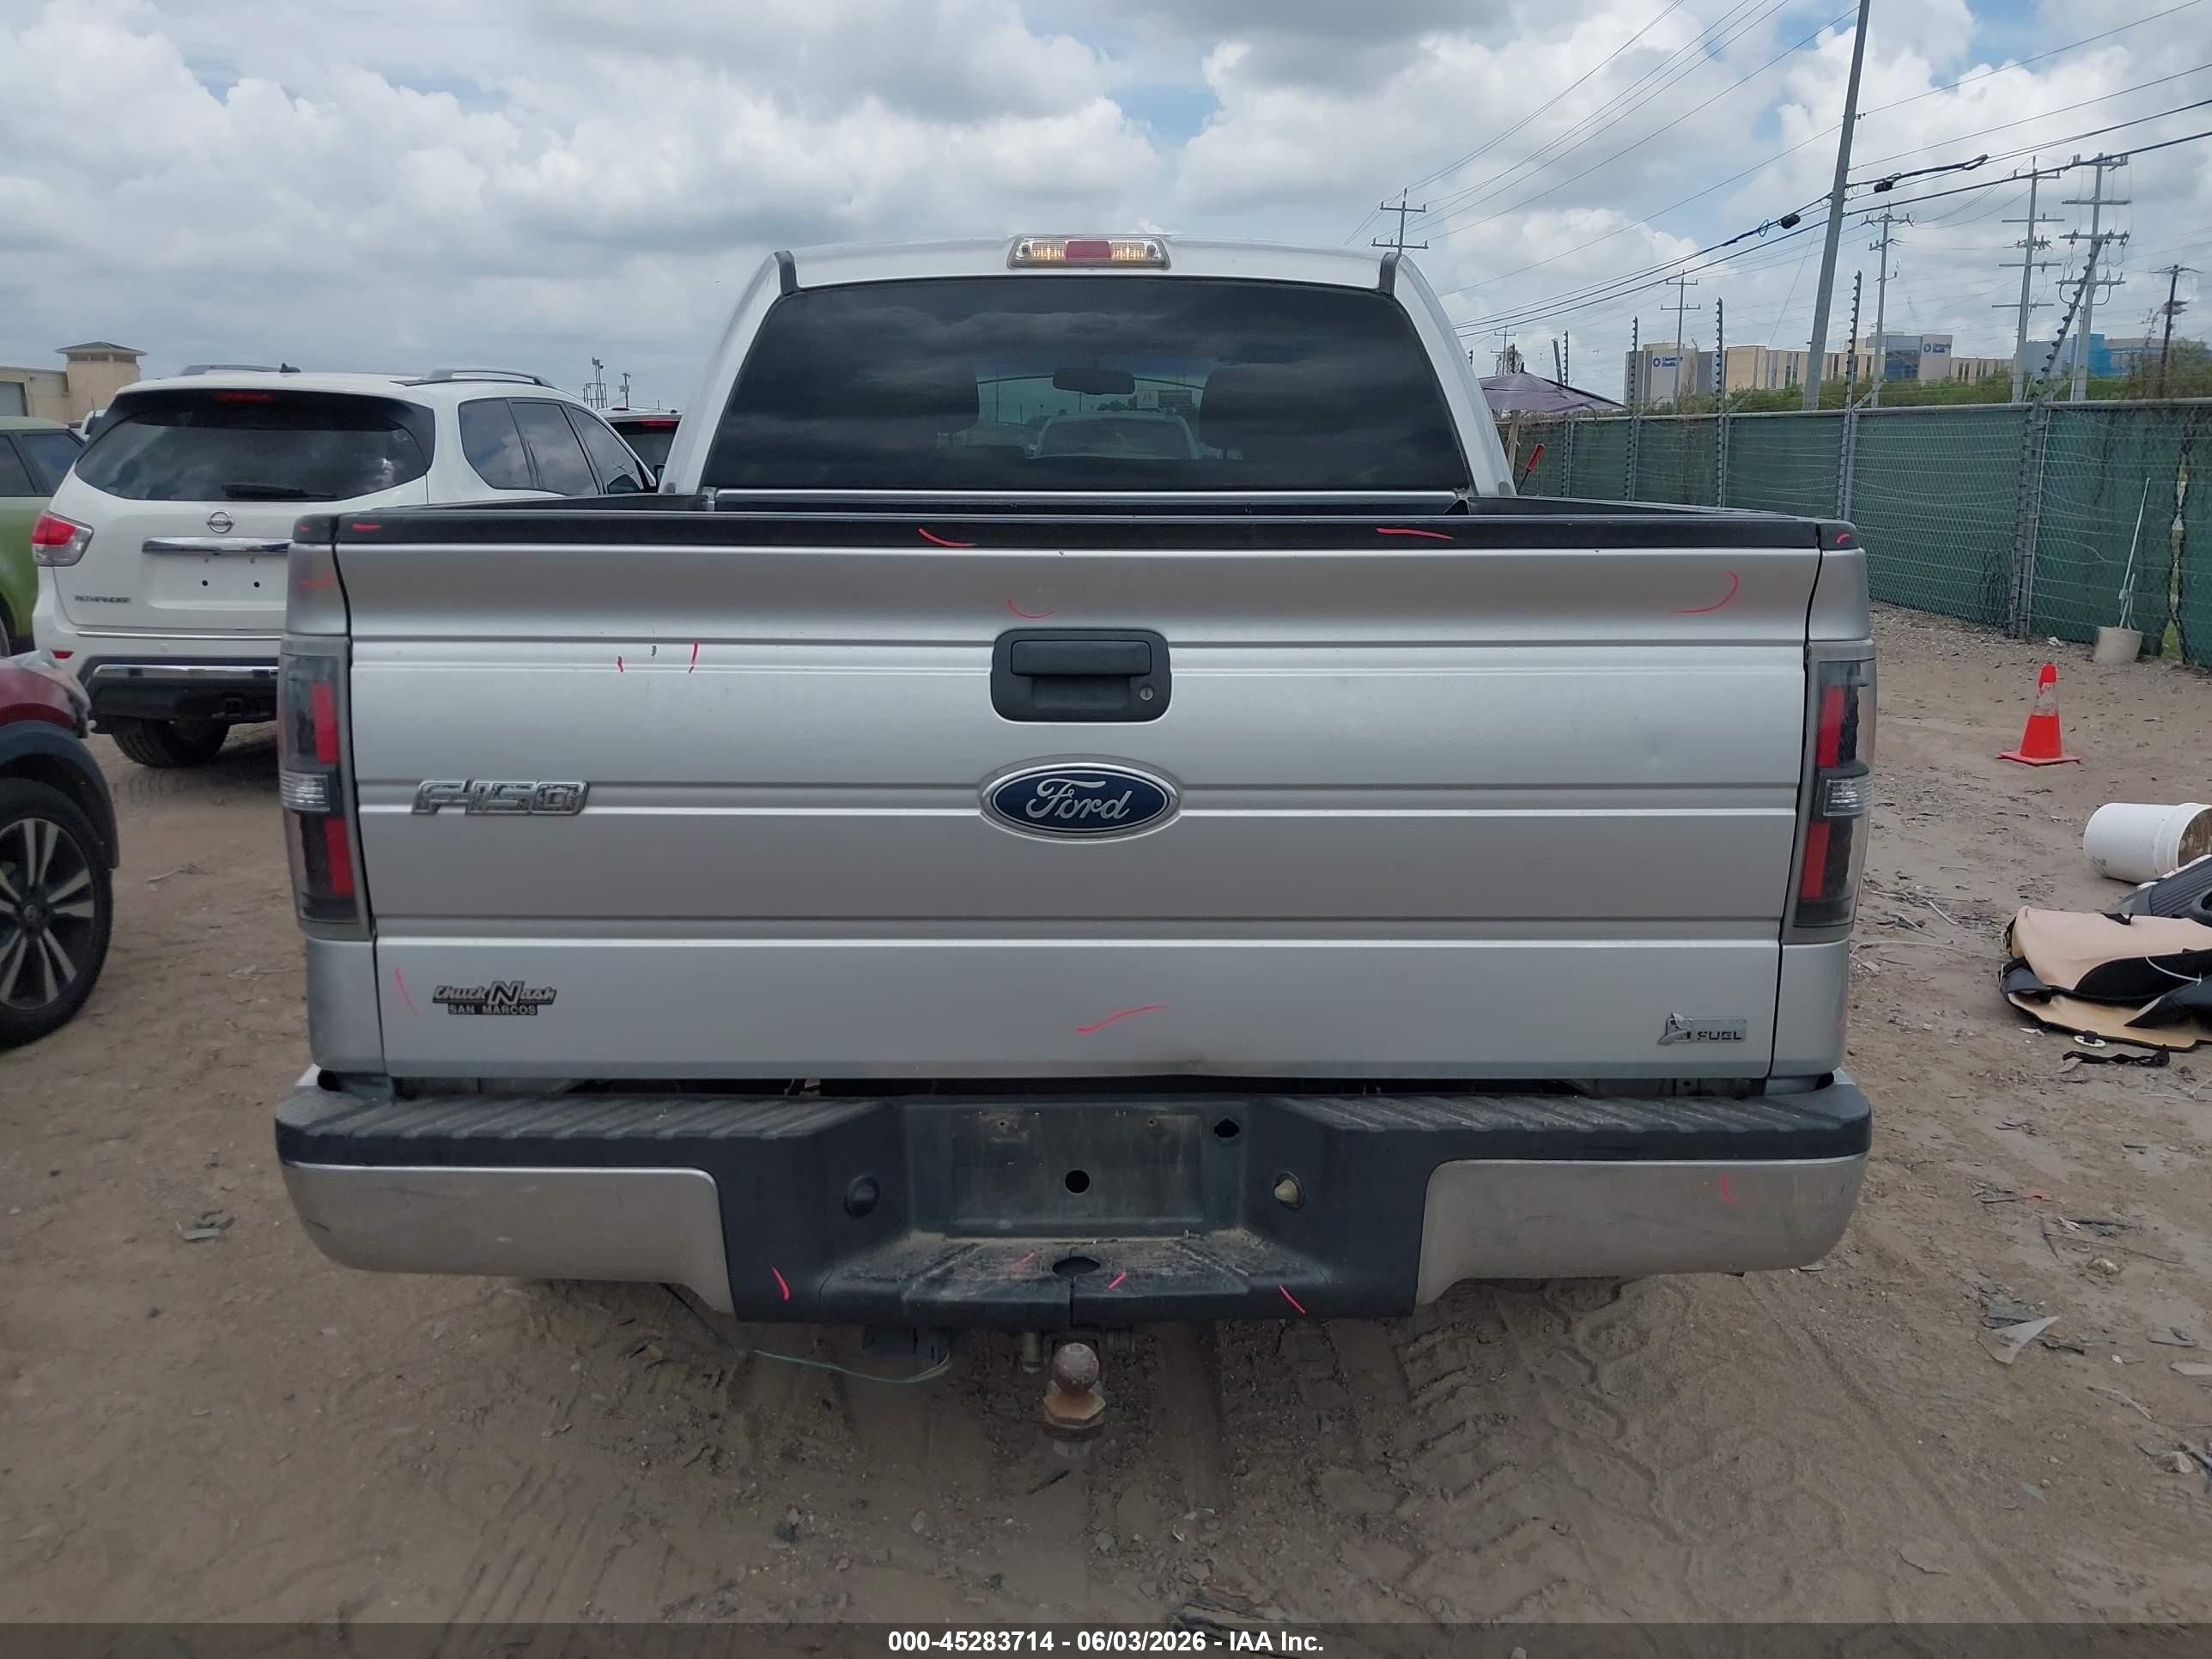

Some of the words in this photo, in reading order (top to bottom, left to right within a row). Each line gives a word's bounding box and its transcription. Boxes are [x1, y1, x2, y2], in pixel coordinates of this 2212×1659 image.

[1025, 778, 1133, 819] Ford
[433, 986, 489, 1002] Chuck
[449, 1005, 475, 1015] SAN
[483, 1005, 537, 1015] MARCOS
